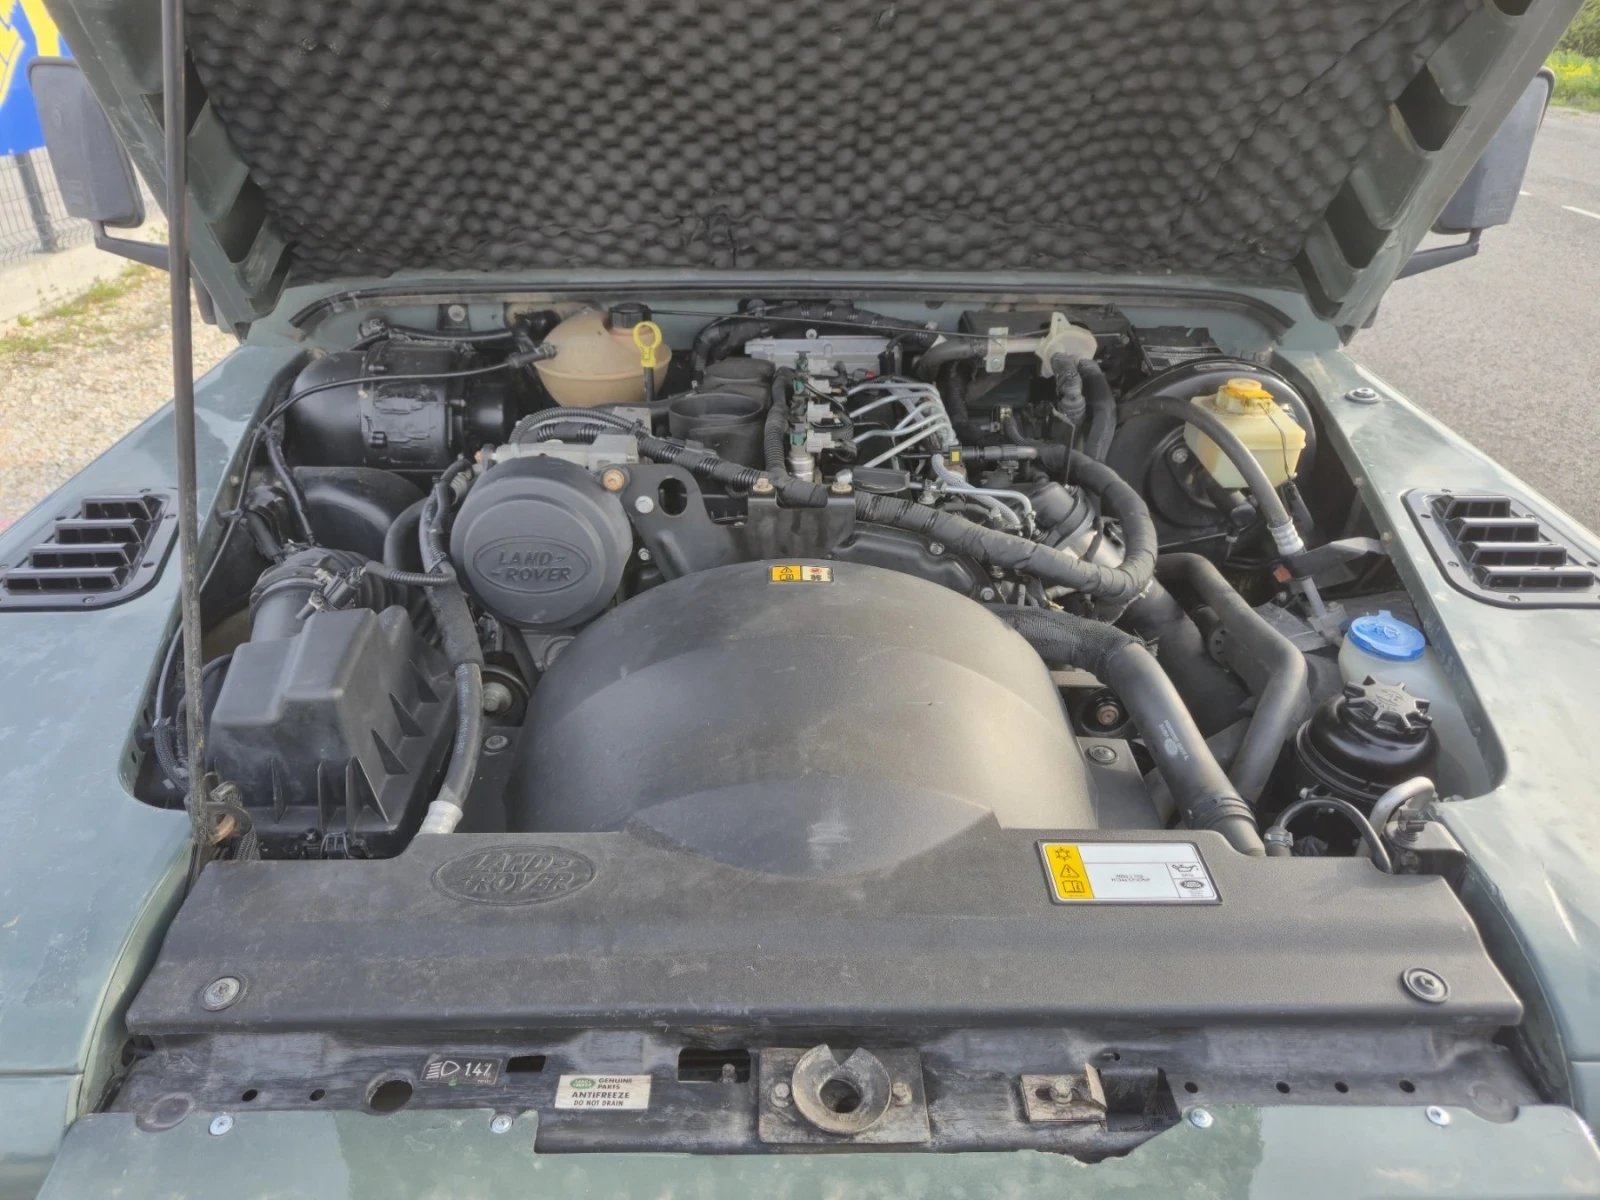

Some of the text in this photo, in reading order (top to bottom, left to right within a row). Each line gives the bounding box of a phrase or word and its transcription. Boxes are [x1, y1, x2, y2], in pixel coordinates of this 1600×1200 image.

[499, 551, 553, 566] LAND
[504, 567, 572, 581] ROVER
[474, 853, 555, 873] LAND
[473, 872, 574, 893] ROVER
[571, 1091, 630, 1099] ANTIFREEZE
